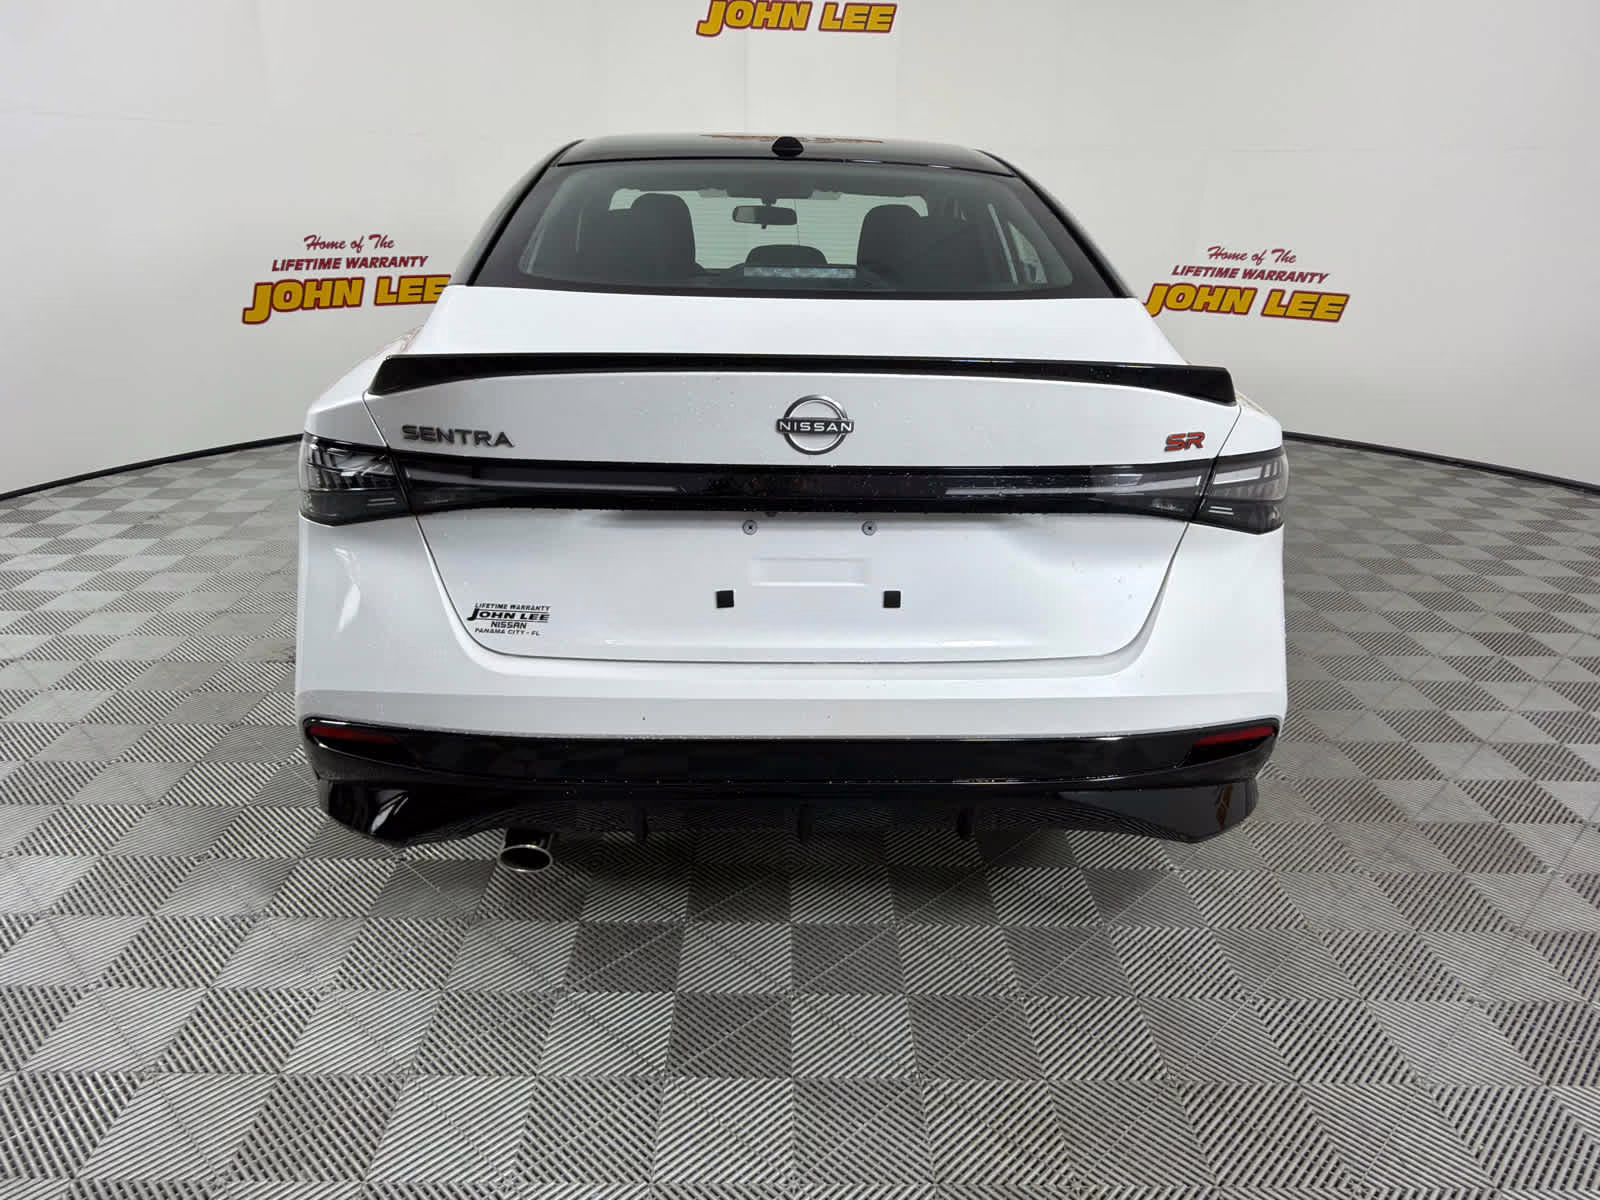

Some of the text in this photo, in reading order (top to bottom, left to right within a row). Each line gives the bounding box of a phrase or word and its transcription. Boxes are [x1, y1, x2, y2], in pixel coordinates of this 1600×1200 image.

[696, 0, 897, 37] JOHN LEE
[303, 234, 394, 253] Home of The
[271, 255, 429, 272] LIFETIME WARRANTY
[1207, 245, 1296, 266] Home of The
[1171, 265, 1329, 284] LIFETIME WARRANTY
[242, 274, 451, 325] JOHN LEE
[1143, 283, 1350, 323] JOHN LEE
[402, 424, 515, 448] SENTRA
[778, 420, 852, 432] NISSAN
[1164, 431, 1206, 452] SR
[466, 608, 550, 621] JOHN LEE
[490, 621, 527, 629] NISSAN
